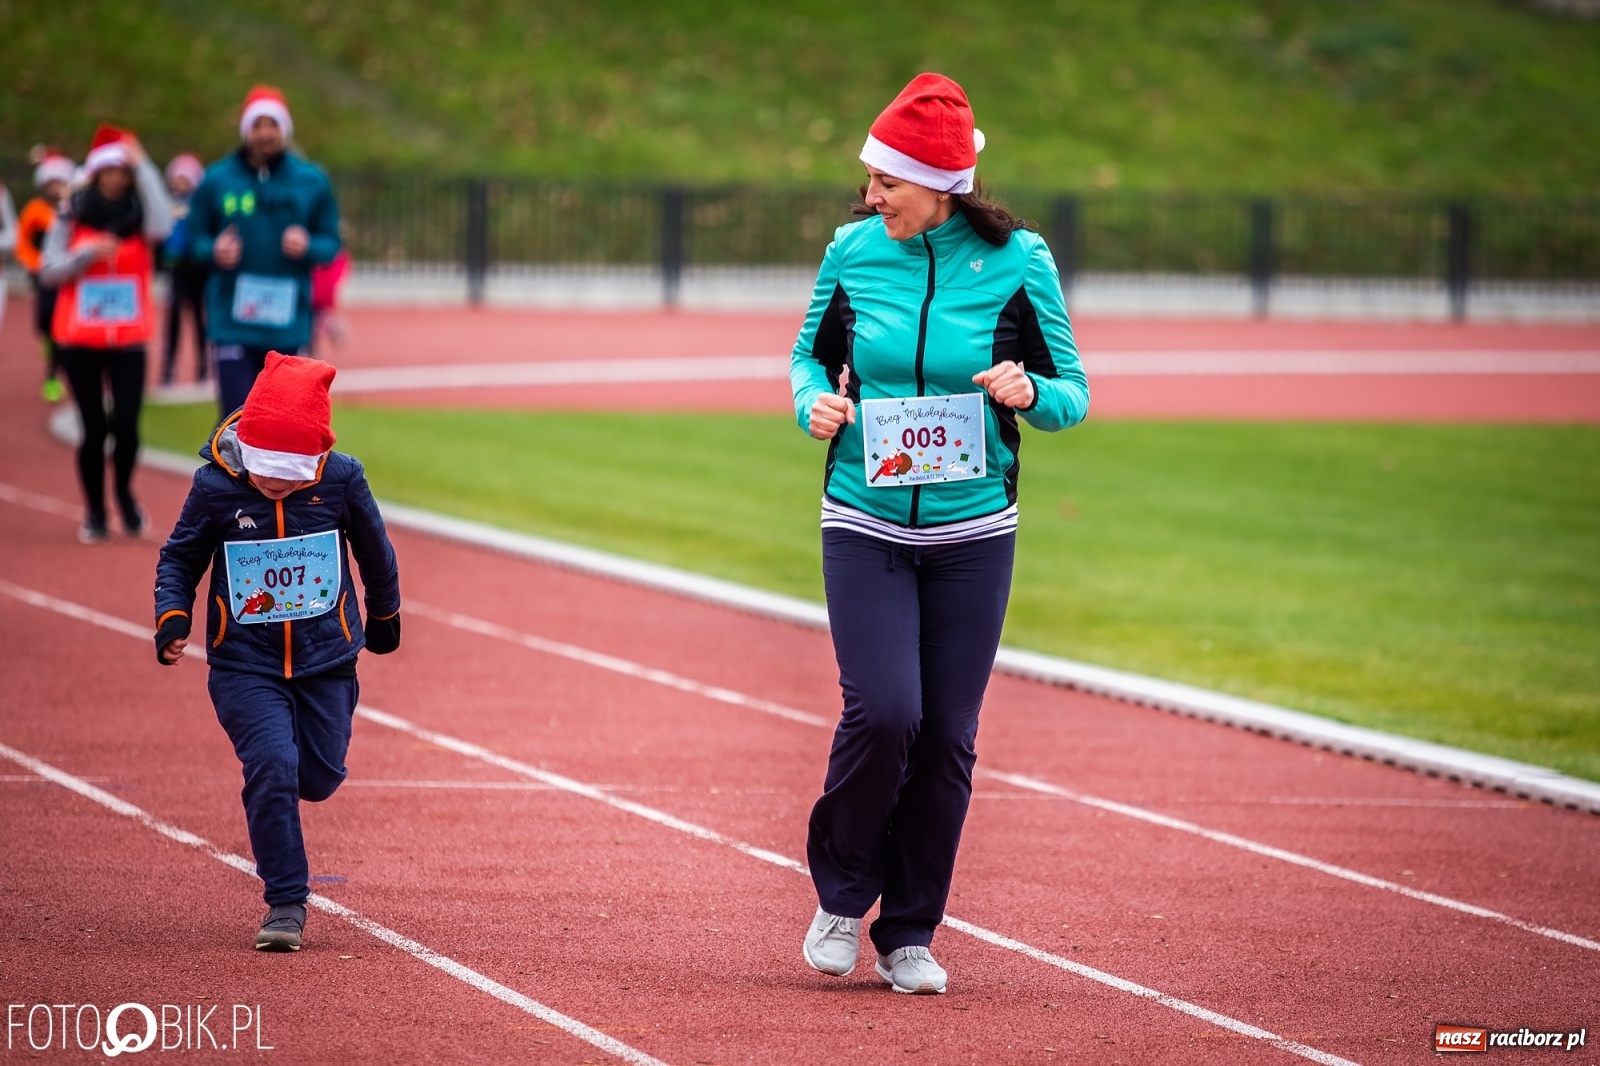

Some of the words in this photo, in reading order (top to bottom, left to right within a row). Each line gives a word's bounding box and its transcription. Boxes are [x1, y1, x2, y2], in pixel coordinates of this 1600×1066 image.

[901, 425, 947, 449] 003
[236, 556, 262, 567] Bieg
[264, 565, 306, 589] 007
